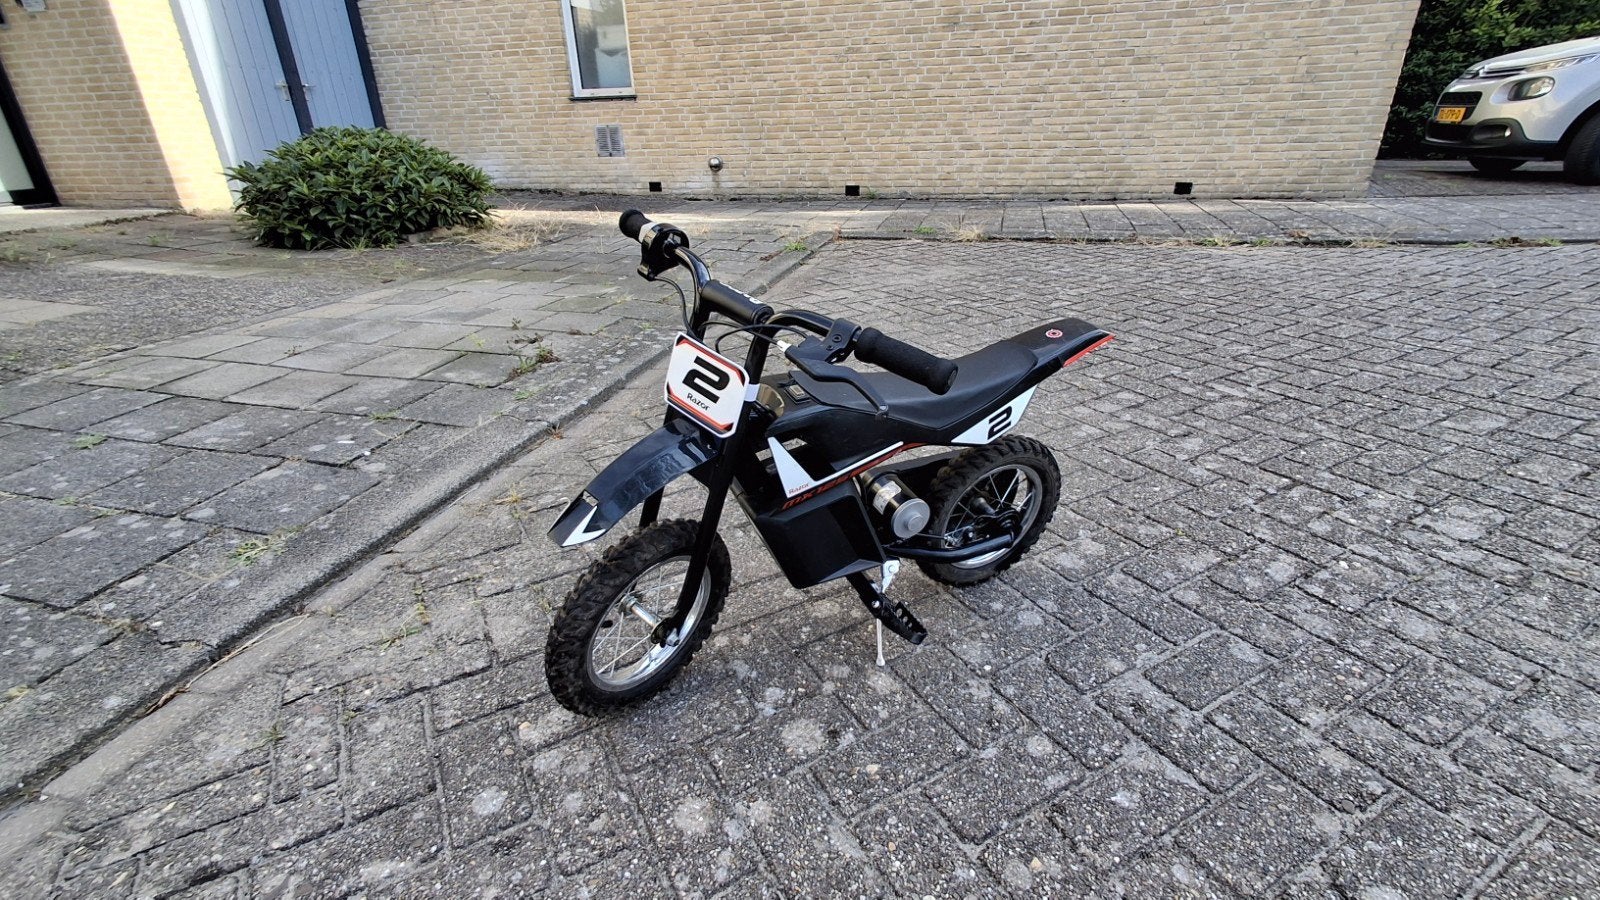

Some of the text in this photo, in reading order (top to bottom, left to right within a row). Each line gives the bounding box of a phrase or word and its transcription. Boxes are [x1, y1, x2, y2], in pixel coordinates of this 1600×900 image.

[682, 355, 730, 404] 2
[686, 392, 711, 411] Razor
[987, 406, 1013, 440] 2
